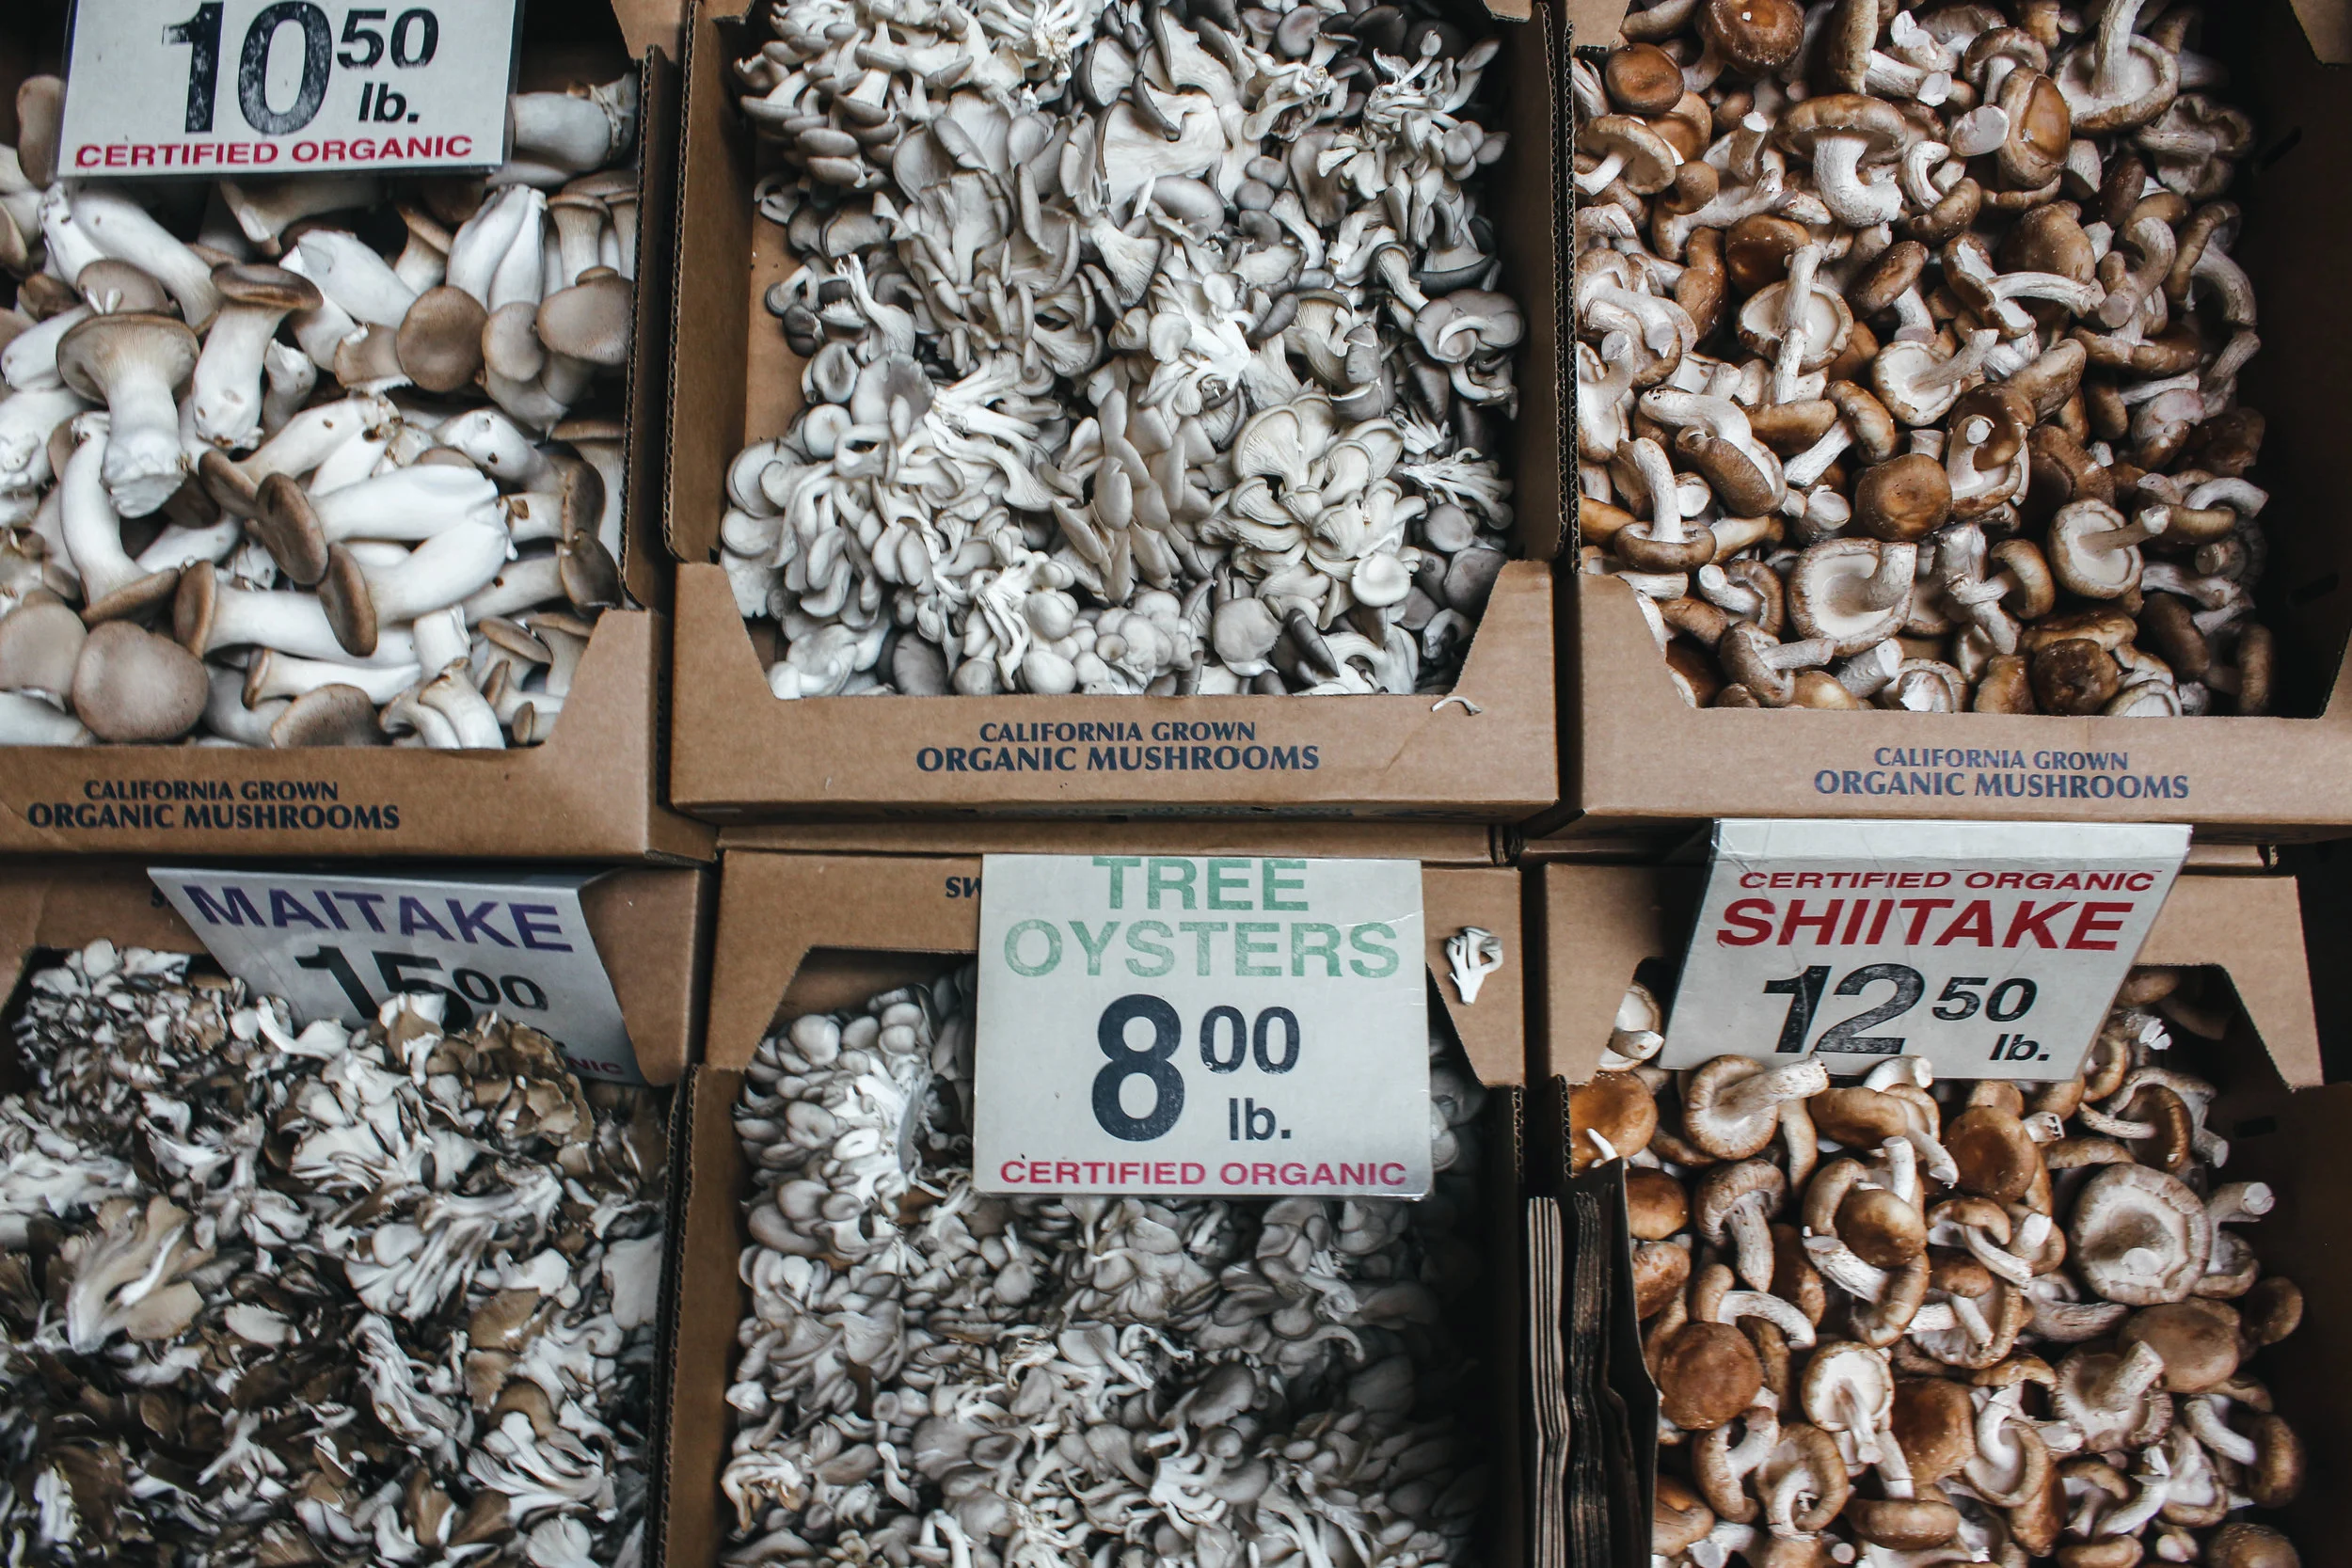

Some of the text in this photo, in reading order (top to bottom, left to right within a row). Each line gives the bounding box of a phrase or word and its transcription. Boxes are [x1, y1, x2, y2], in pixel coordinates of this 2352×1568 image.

[163, 0, 438, 135] 10 50
[358, 82, 420, 123] lb.
[75, 135, 472, 167] CERTIFIED ORGANIC
[980, 721, 1255, 742] CALIFORNIA GROWN
[916, 746, 1319, 771] ORGANIC MUSHROOMS
[1874, 748, 2128, 771] CALIFORNIA GROWN
[84, 780, 339, 801] CALIFORNIA GROWN
[1814, 769, 2189, 799] ORGANIC MUSHROOMS
[27, 802, 400, 830] ORGANIC MUSHROOMS
[1092, 857, 1309, 911] TREE
[1739, 871, 2155, 892] CERTIFIED ORGANIC
[183, 884, 573, 952] MAITAKE
[1716, 898, 2134, 951] SHIITAKE
[1004, 919, 1399, 979] OYSTERS
[453, 968, 548, 1011] 00
[1763, 963, 2038, 1055] 12 50
[1989, 1034, 2050, 1062] lb.
[1091, 994, 1300, 1142] 8 00
[1229, 1097, 1292, 1141] lb.
[1000, 1160, 1406, 1186] CERTIFIED ORGANIC
